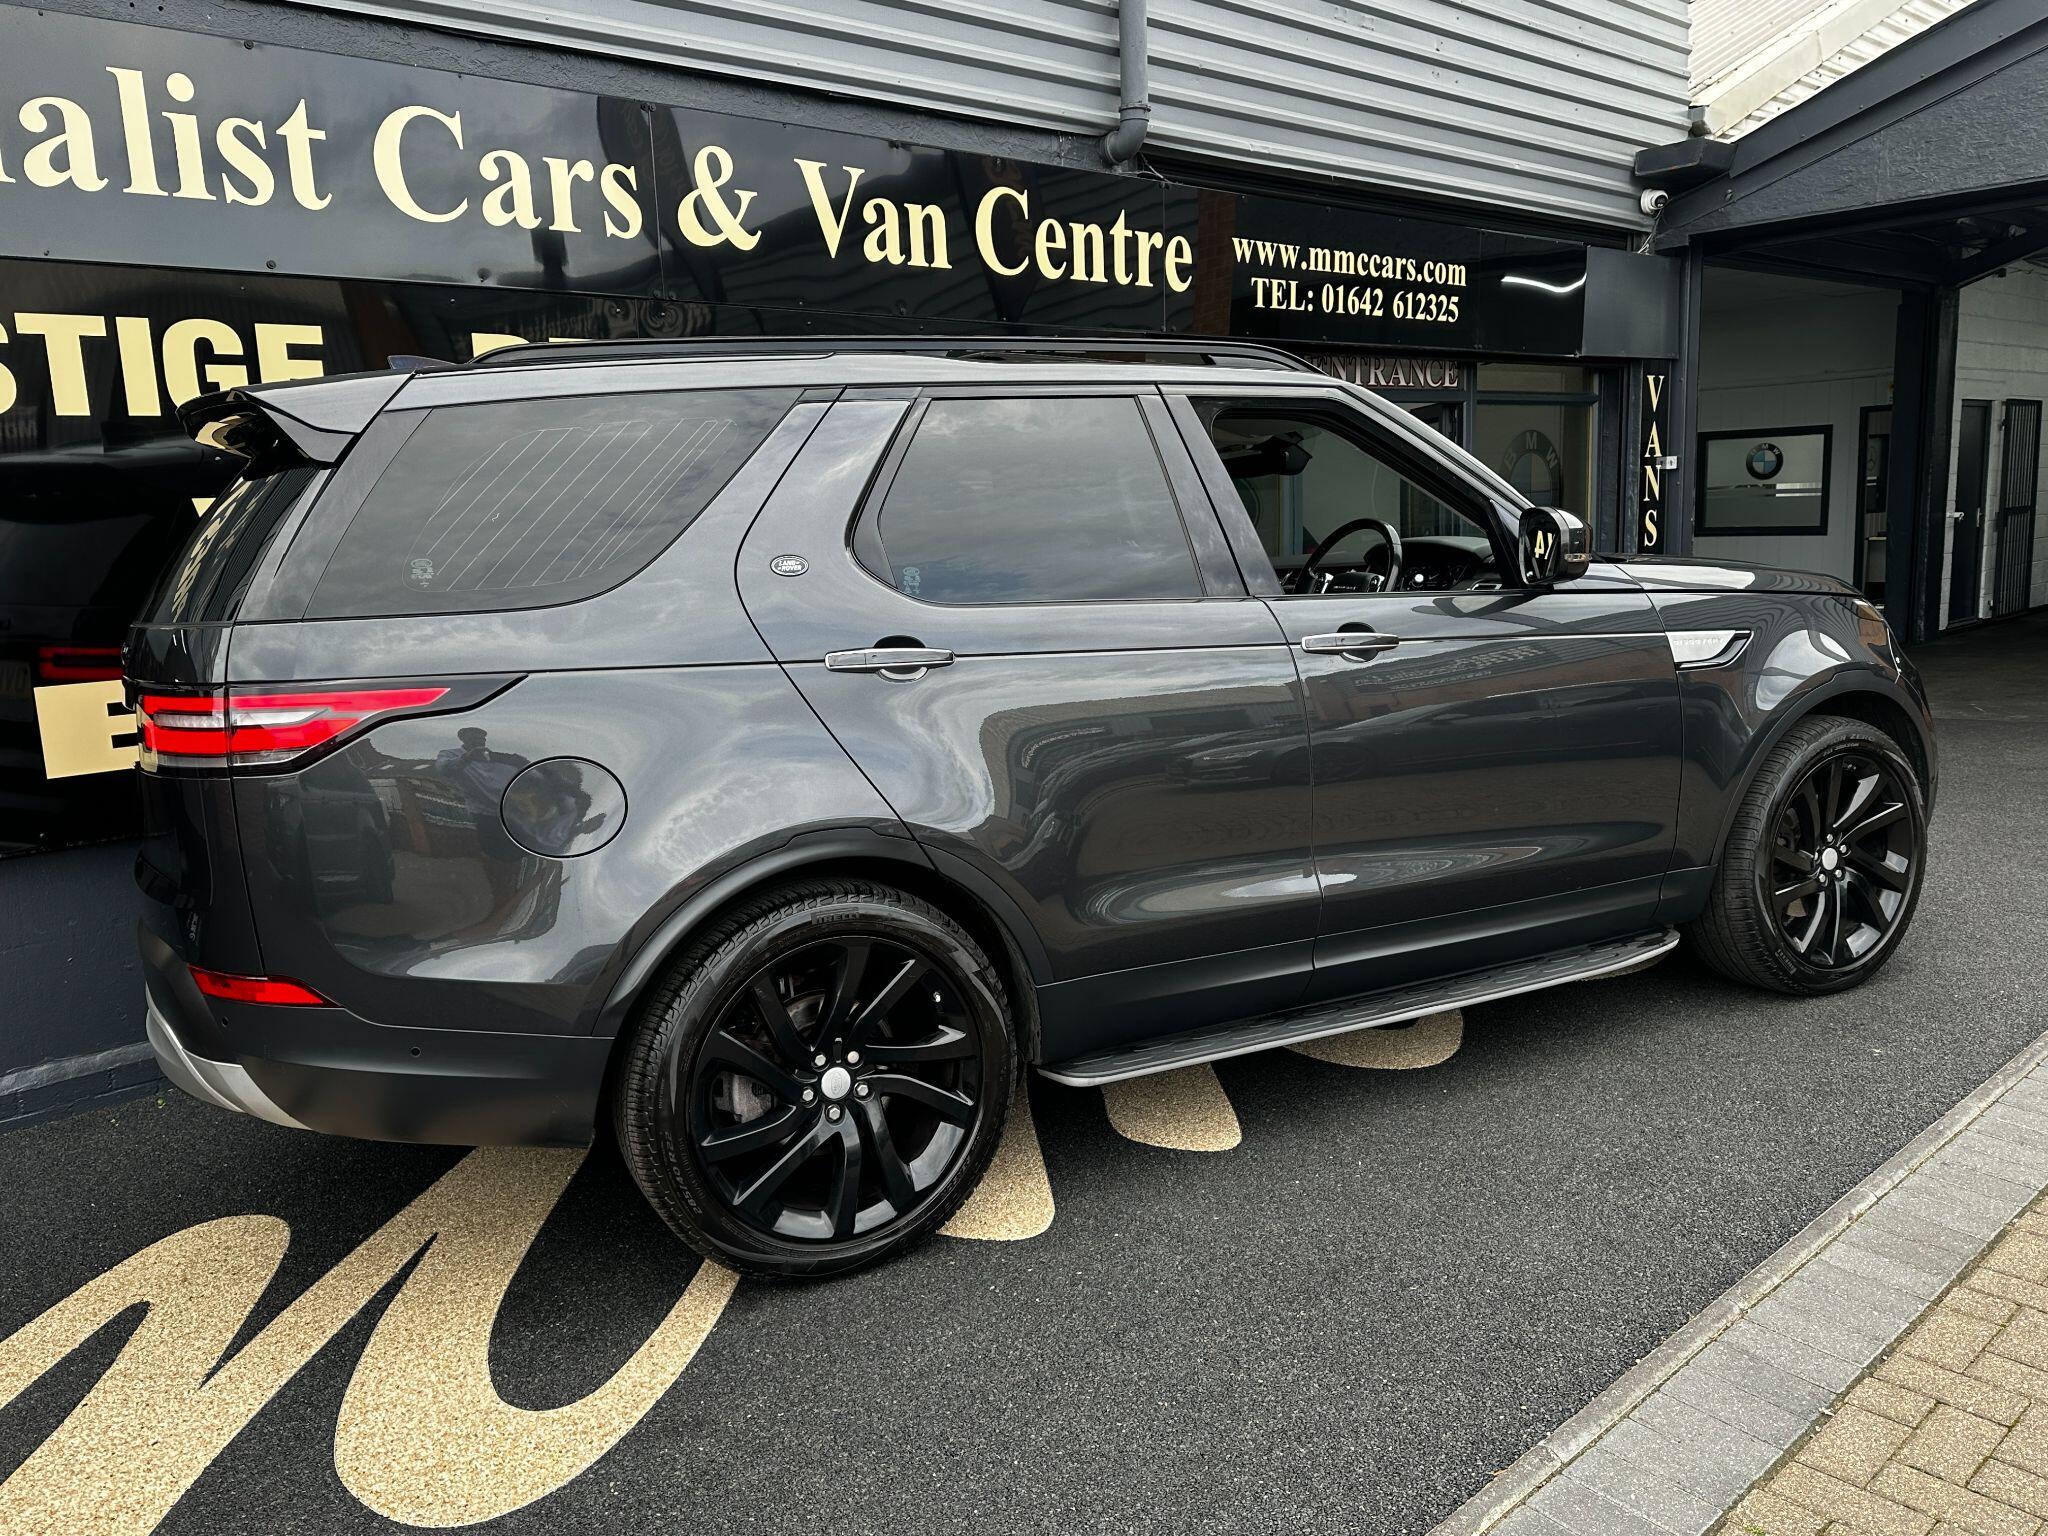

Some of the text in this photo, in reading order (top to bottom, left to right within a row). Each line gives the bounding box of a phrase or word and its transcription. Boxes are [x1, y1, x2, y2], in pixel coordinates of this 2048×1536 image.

[0, 66, 1193, 293] alist Cars & Van Centre
[1232, 237, 1467, 287] www.mmccars.com
[1251, 277, 1459, 323] TEL: 01642 612325
[0, 312, 326, 417] TIGE
[1643, 374, 1664, 547] VANS
